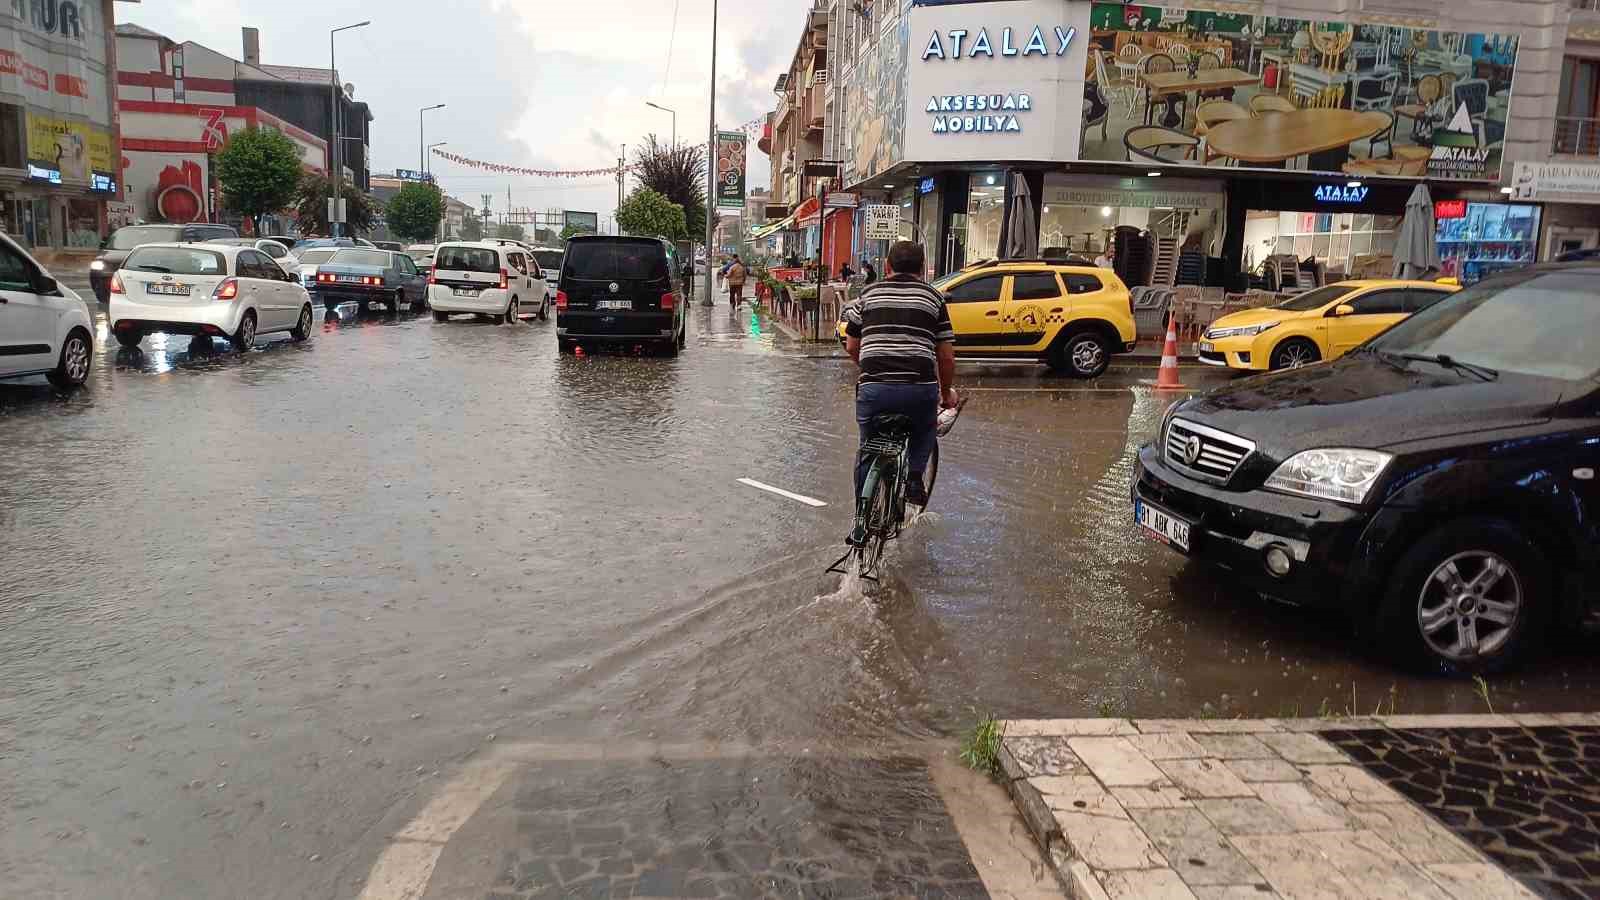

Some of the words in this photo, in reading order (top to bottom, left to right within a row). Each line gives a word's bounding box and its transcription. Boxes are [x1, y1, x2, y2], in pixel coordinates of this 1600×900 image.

[921, 25, 1077, 61] ATALAY
[926, 93, 1033, 113] AKSESUAR
[932, 114, 1020, 133] MOBİLYA
[1443, 147, 1489, 162] ATALAY
[1314, 184, 1369, 199] ATALAY
[1141, 506, 1149, 525] 81
[1173, 522, 1188, 546] 646
